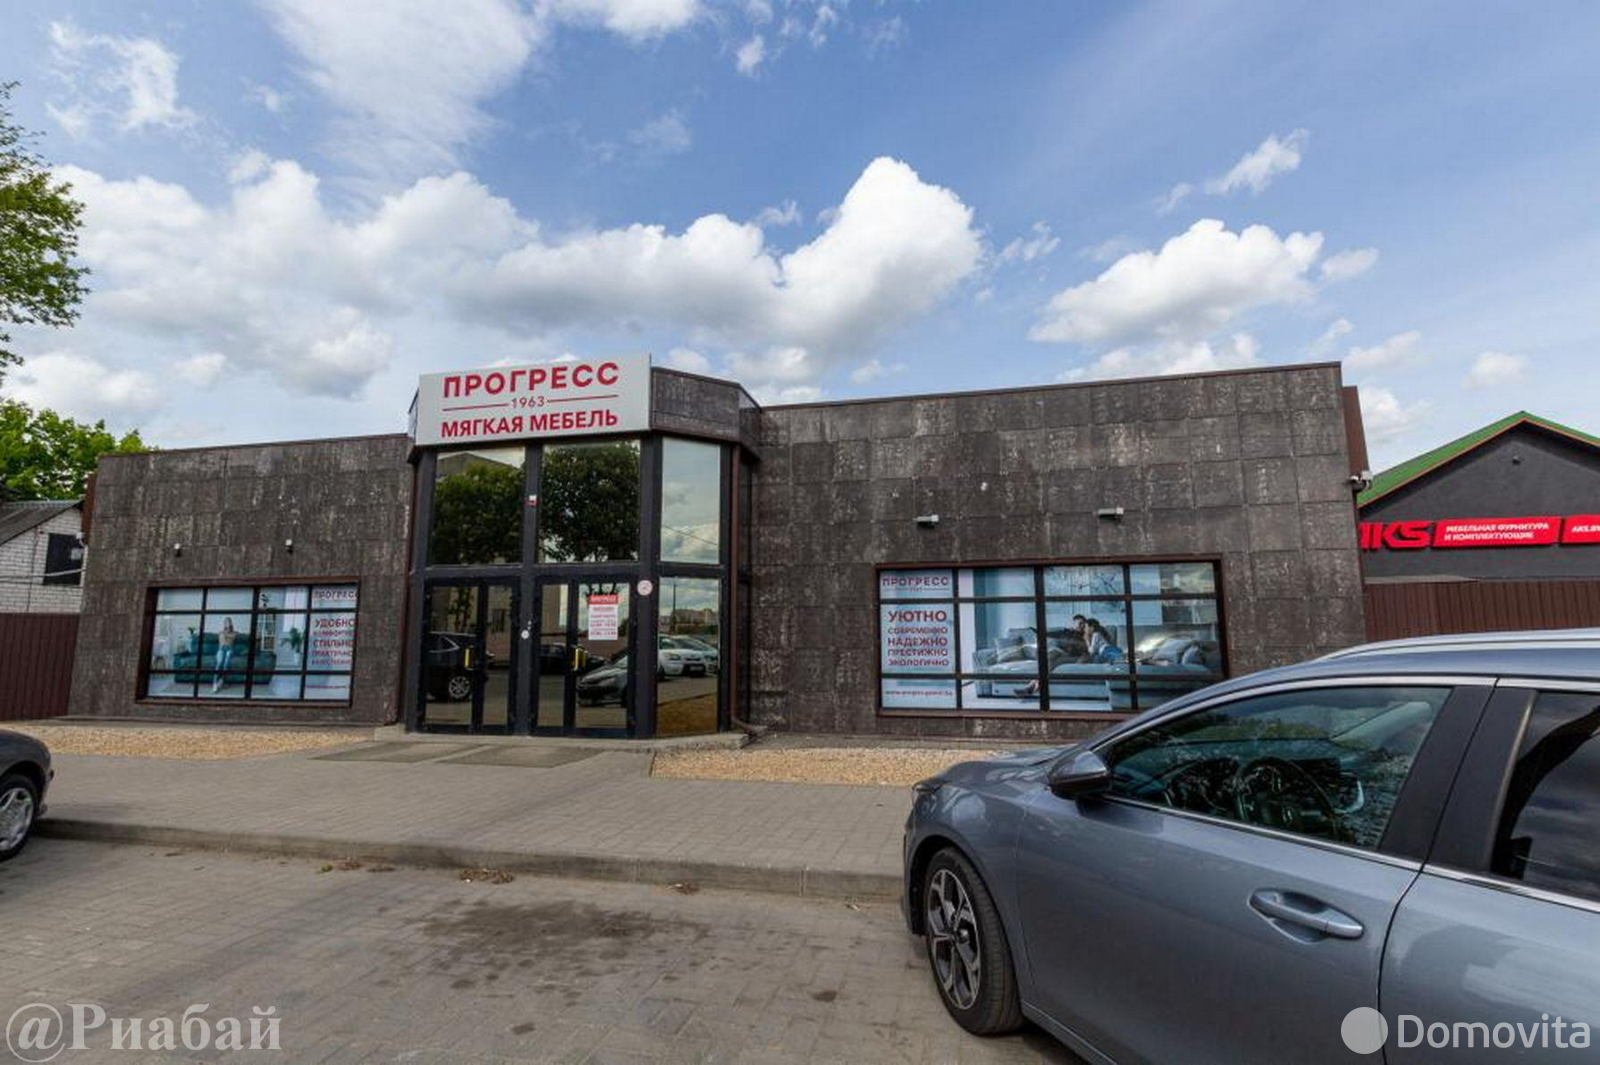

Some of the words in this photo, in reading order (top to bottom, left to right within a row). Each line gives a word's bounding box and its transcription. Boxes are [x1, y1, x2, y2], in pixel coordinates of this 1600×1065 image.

[443, 362, 619, 398] ПРОГРЕСС
[511, 396, 545, 410] 1963
[441, 415, 523, 438] МЯГКАЯ
[529, 409, 618, 433] МЕБЕЛЬ
[1446, 523, 1495, 533] МЕБЕЛЬНАЯ
[1497, 522, 1549, 531] ФУРНИТУРА
[1452, 531, 1534, 541] КОМПЛЕКТУЮЩИЕ
[882, 576, 949, 587] ПРОГРЕСС
[888, 610, 947, 622] УЮТНО
[315, 618, 357, 629] УДОБНО
[313, 639, 356, 649] СТИЛЬНО
[887, 637, 948, 647] НАДЕЖНО
[887, 648, 948, 657] ПРЕСТИЖНО
[887, 658, 949, 667] ЭКОЛОГИЧНО
